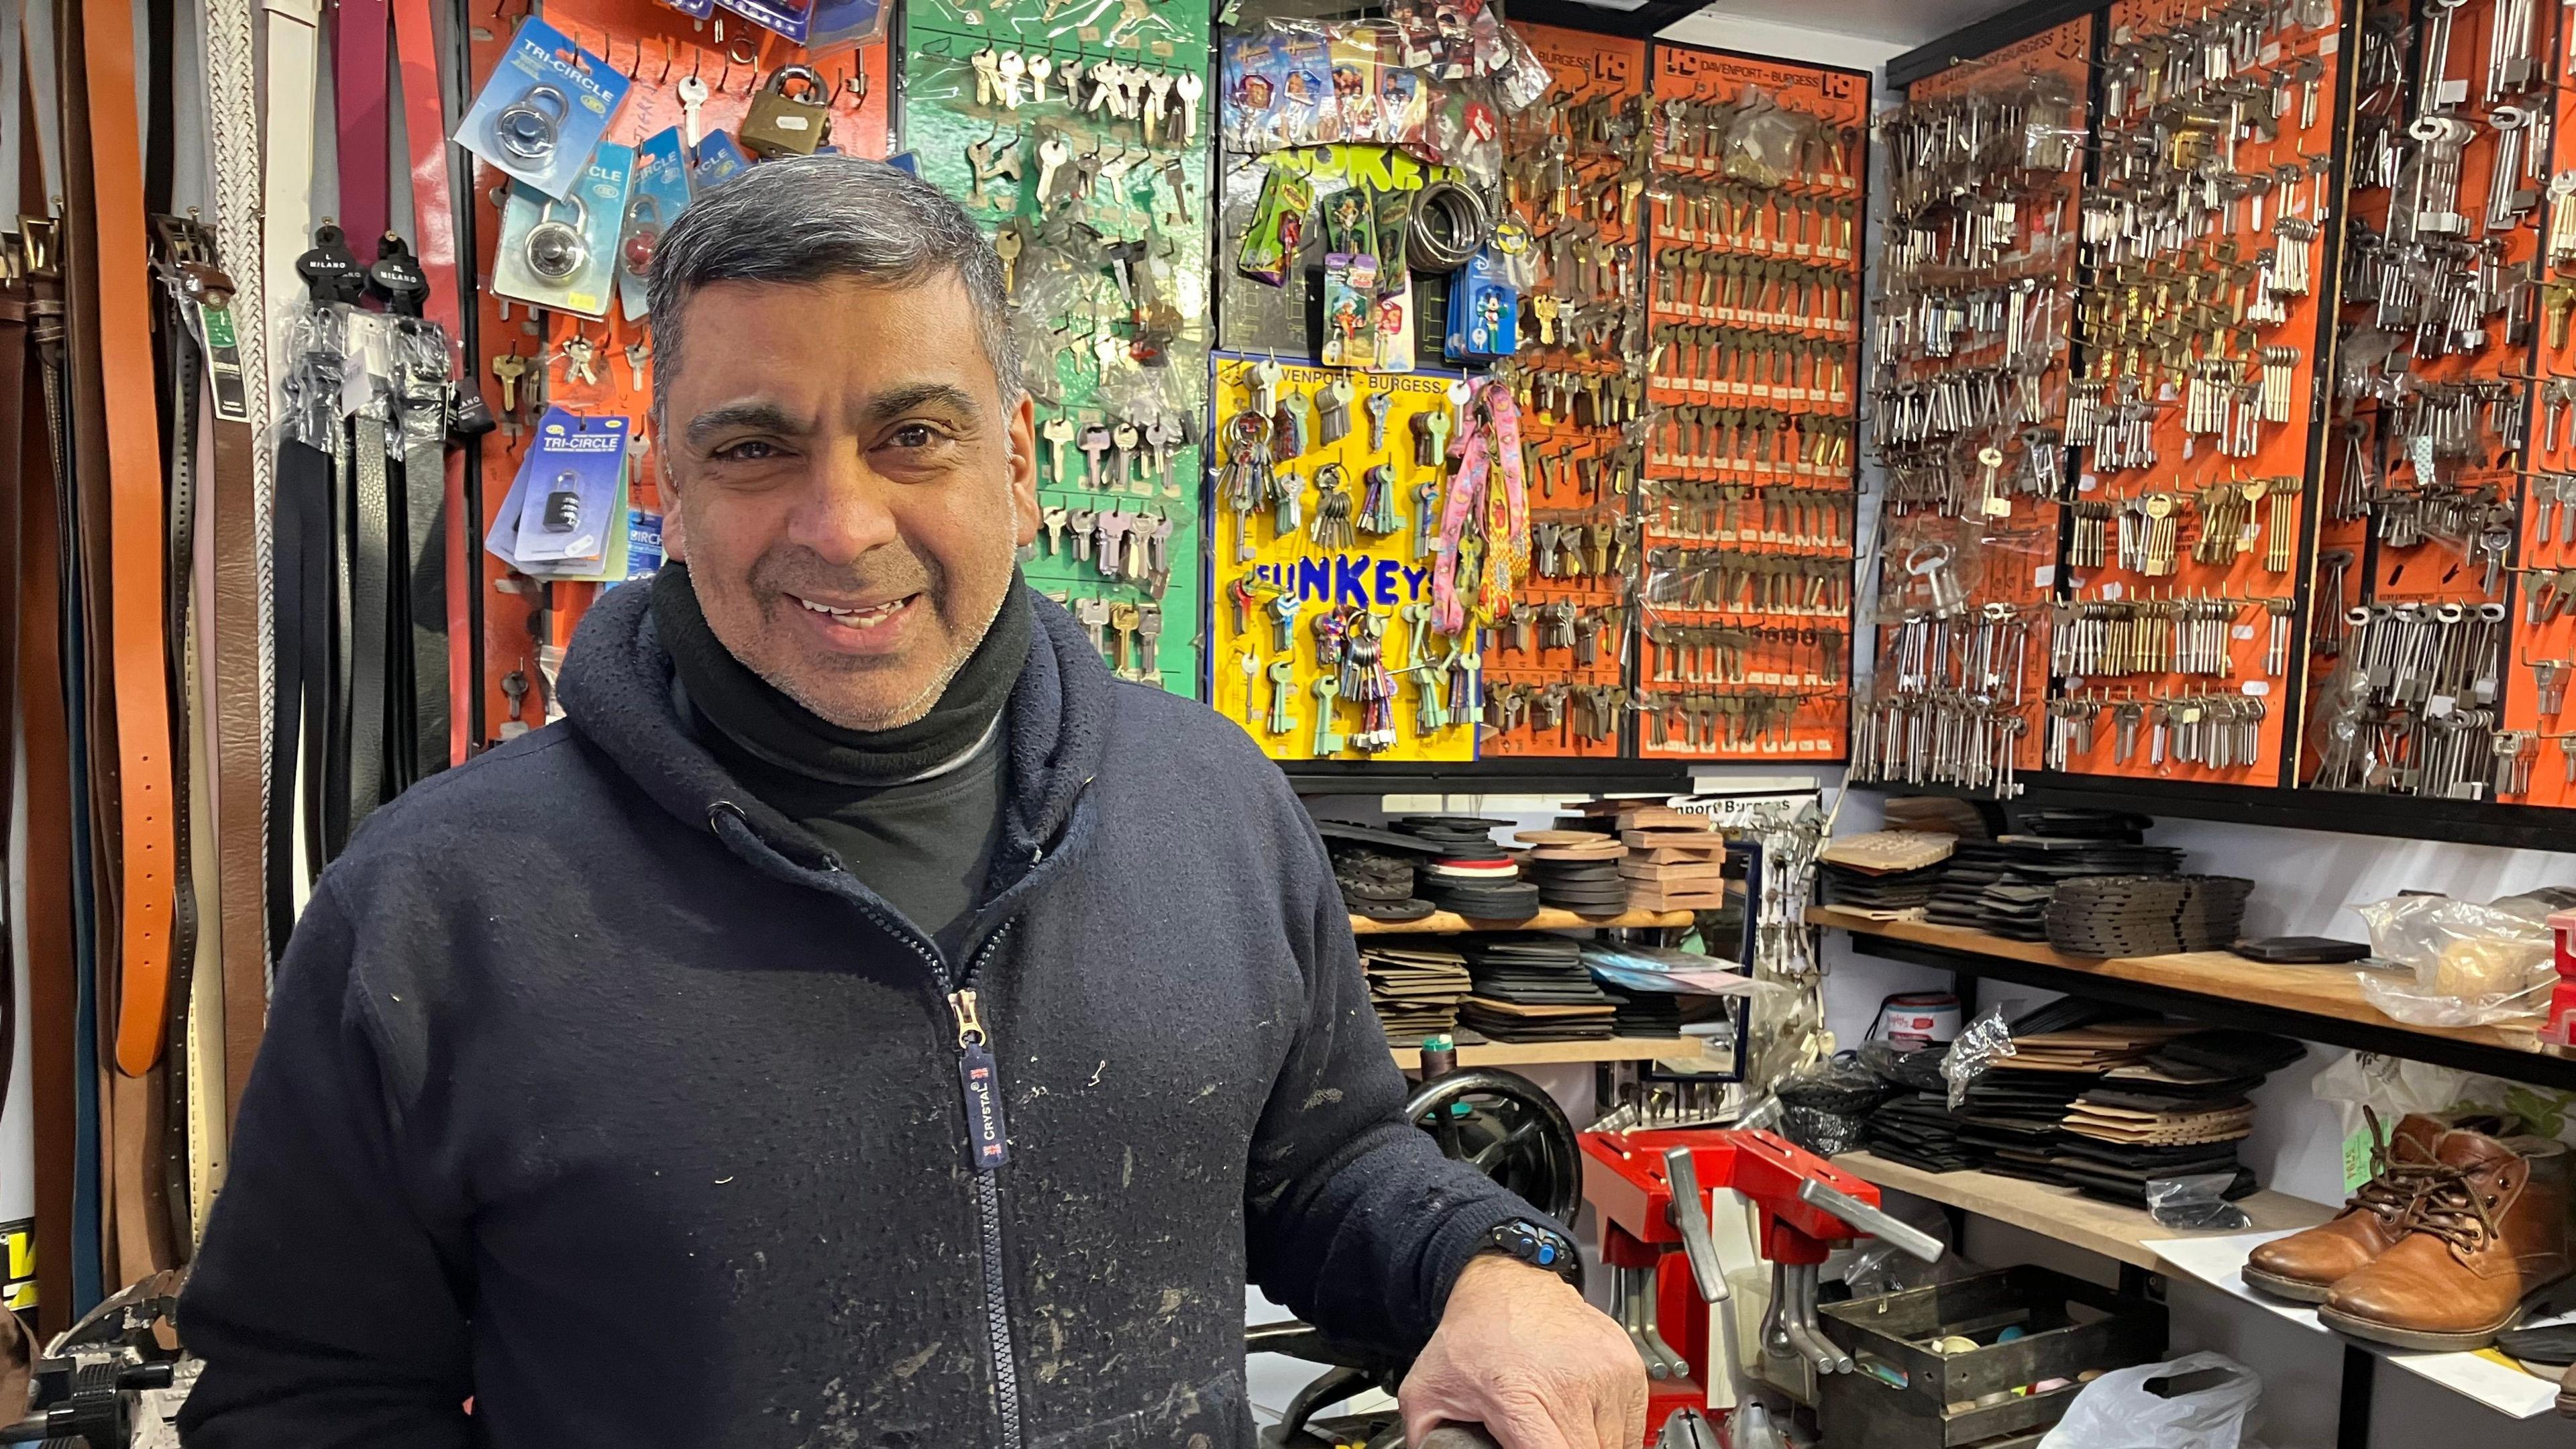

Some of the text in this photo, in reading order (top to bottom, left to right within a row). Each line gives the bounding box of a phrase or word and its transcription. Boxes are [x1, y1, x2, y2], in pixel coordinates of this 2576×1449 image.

[525, 38, 614, 103] TRI-CIRCLE
[1700, 60, 1763, 78] DAVENPORT
[380, 271, 417, 283] MILANO
[1368, 376, 1442, 394] BURGESS
[544, 437, 619, 448] TRI-CIRCLE
[1256, 553, 1434, 610] FUNKEY
[977, 1082, 996, 1140] CRYSTAL
